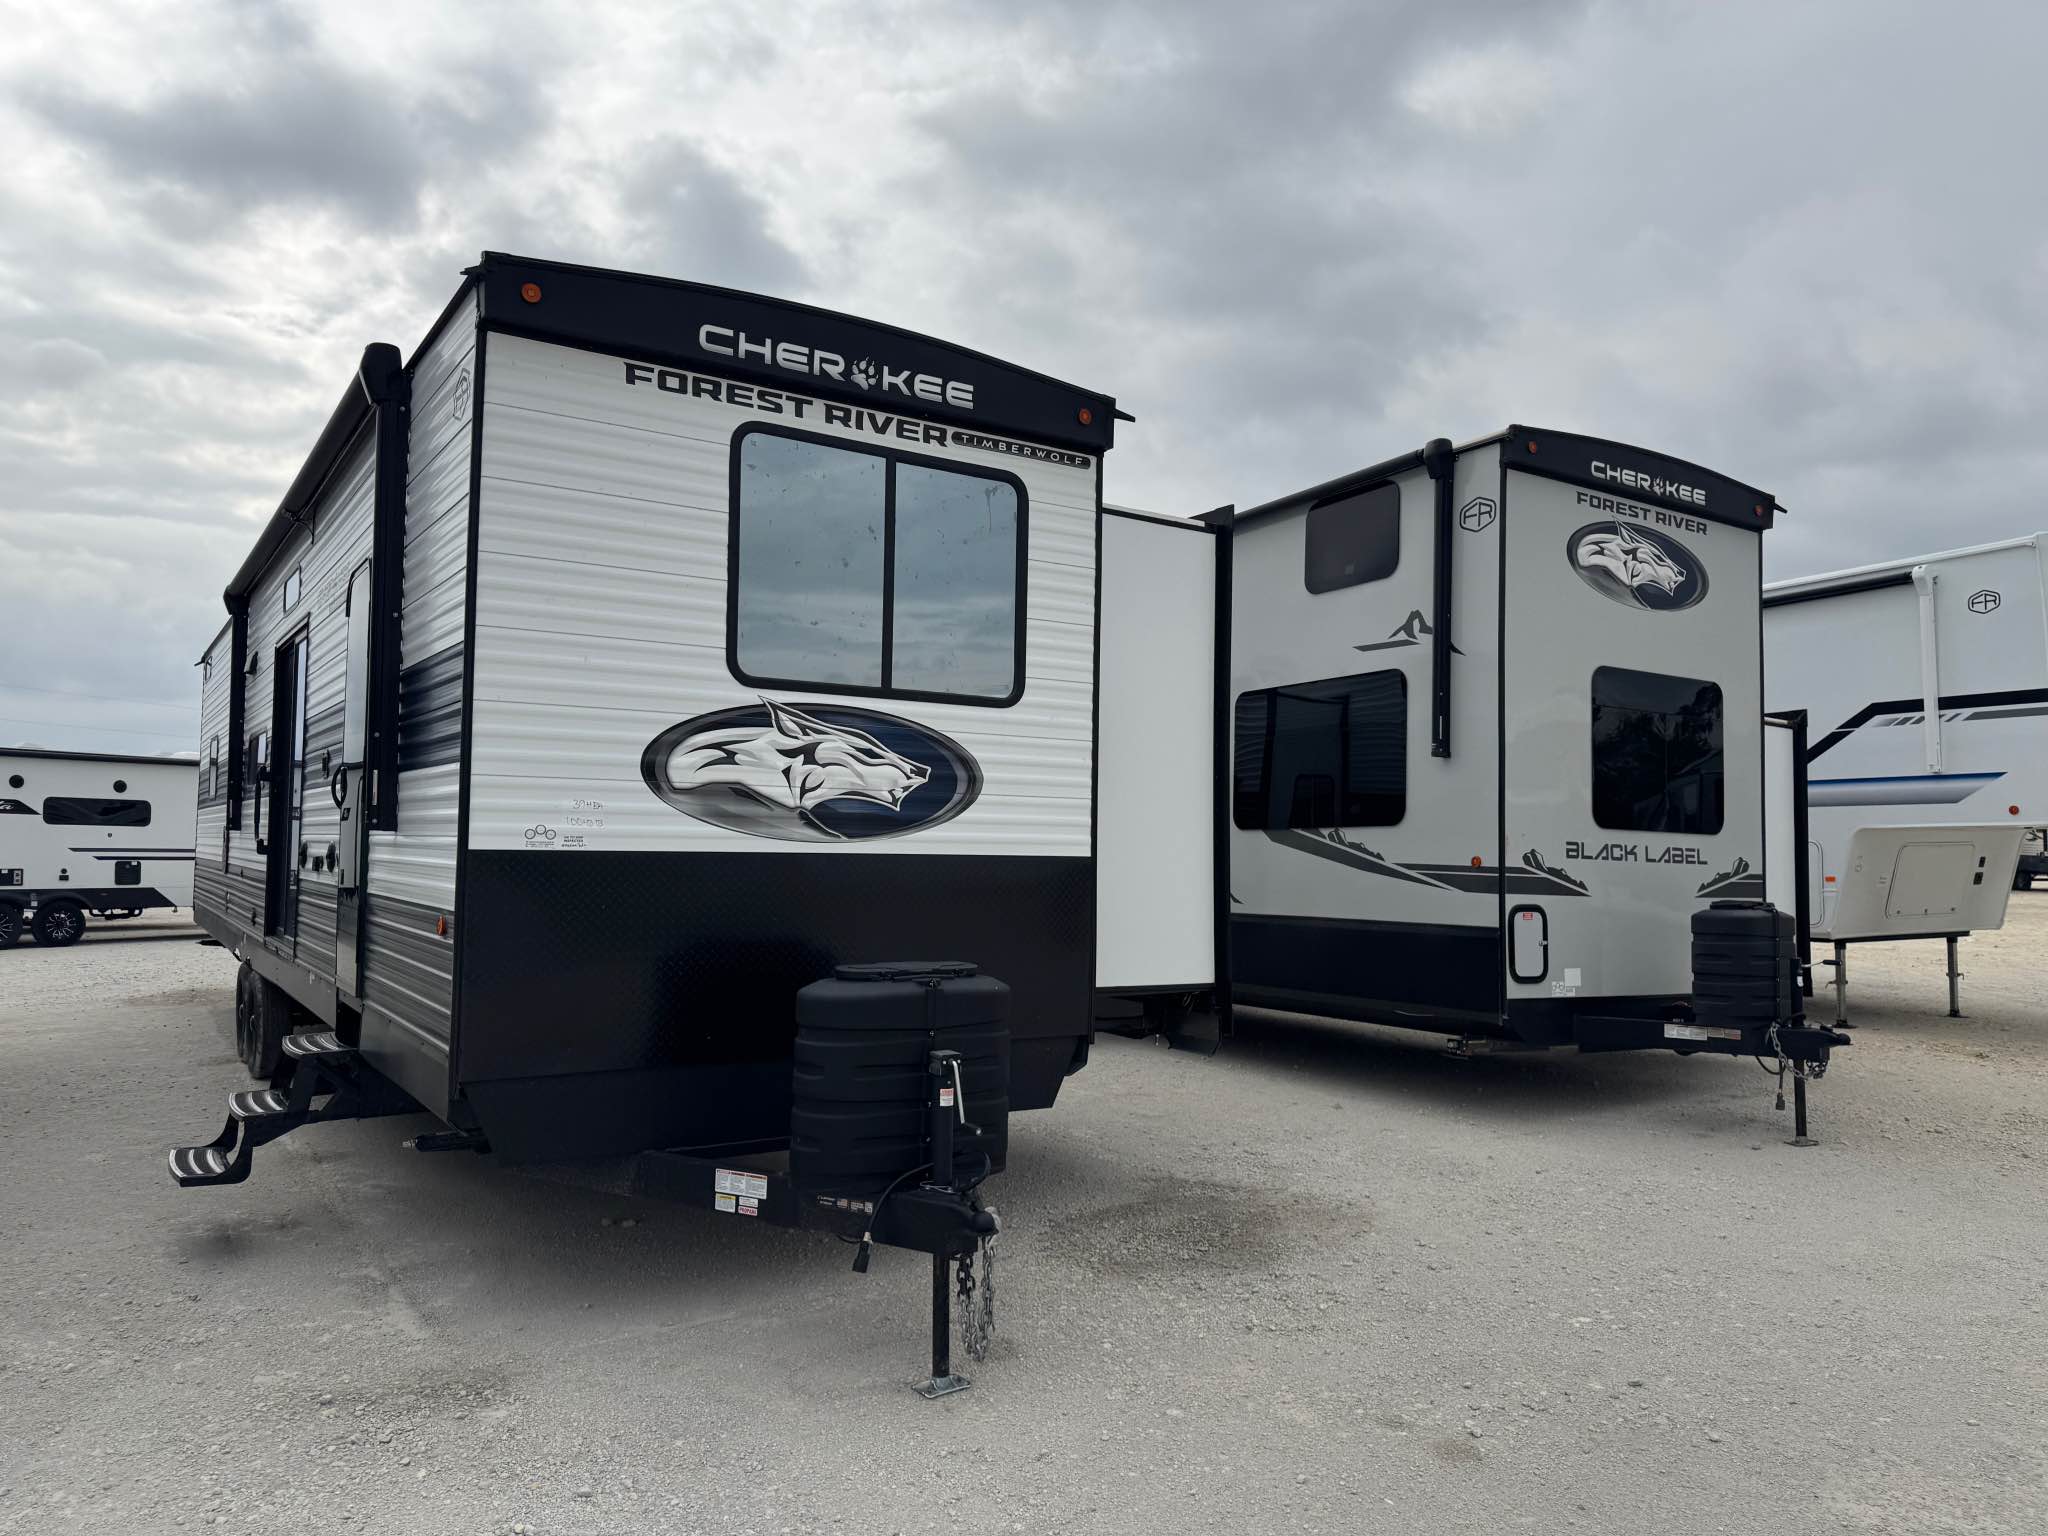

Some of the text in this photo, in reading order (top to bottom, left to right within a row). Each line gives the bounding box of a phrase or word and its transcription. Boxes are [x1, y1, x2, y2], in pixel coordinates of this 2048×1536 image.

[623, 360, 949, 448] FOREST RIVER
[960, 433, 1084, 466] TIMBERWOLF
[1576, 490, 1708, 536] FOREST RIVER
[1565, 840, 1708, 865] BLACK LABEL
